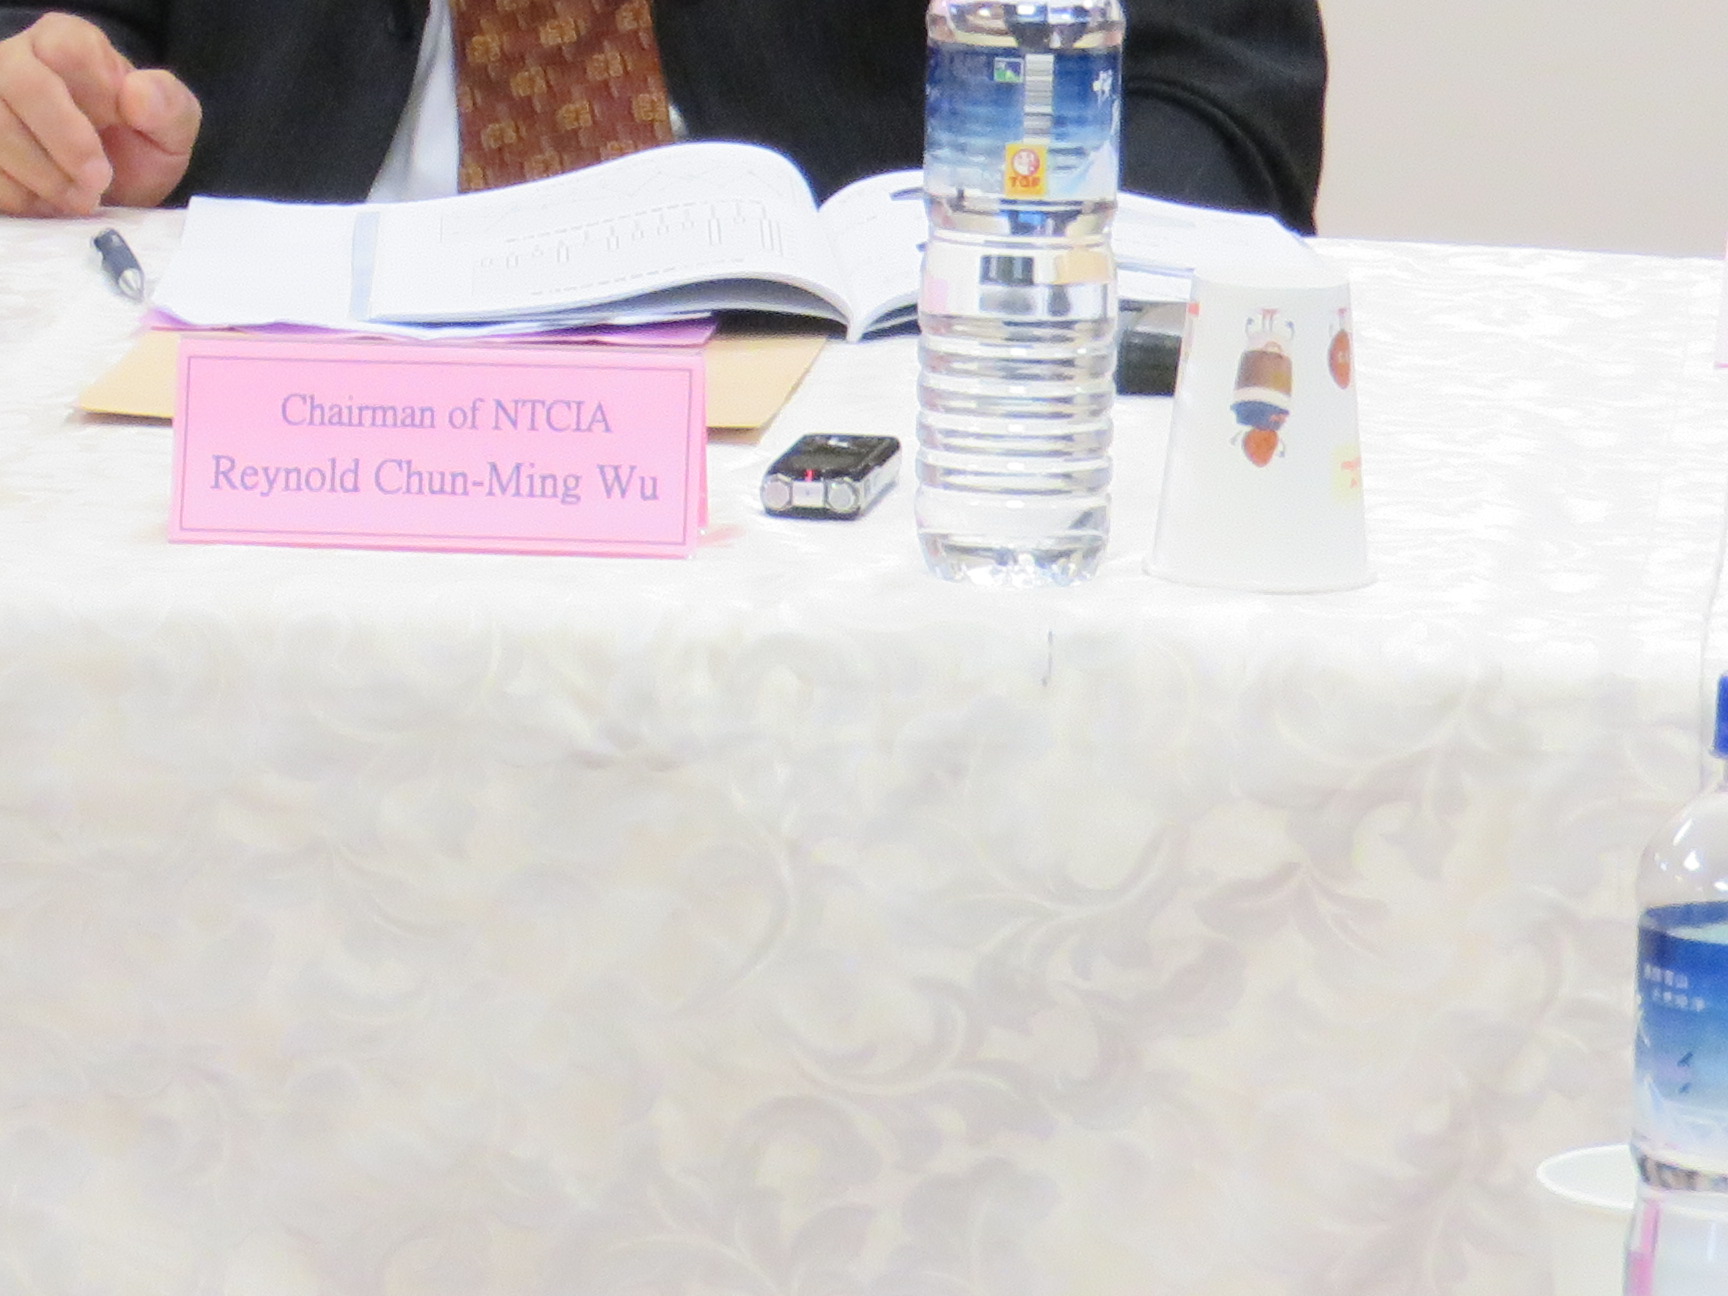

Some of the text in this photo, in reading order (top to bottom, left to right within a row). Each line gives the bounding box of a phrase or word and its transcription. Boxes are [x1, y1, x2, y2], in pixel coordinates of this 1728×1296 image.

[280, 392, 613, 433] Chairman of NTCIA
[209, 453, 660, 505] Reynold Chun-Ming Wu
